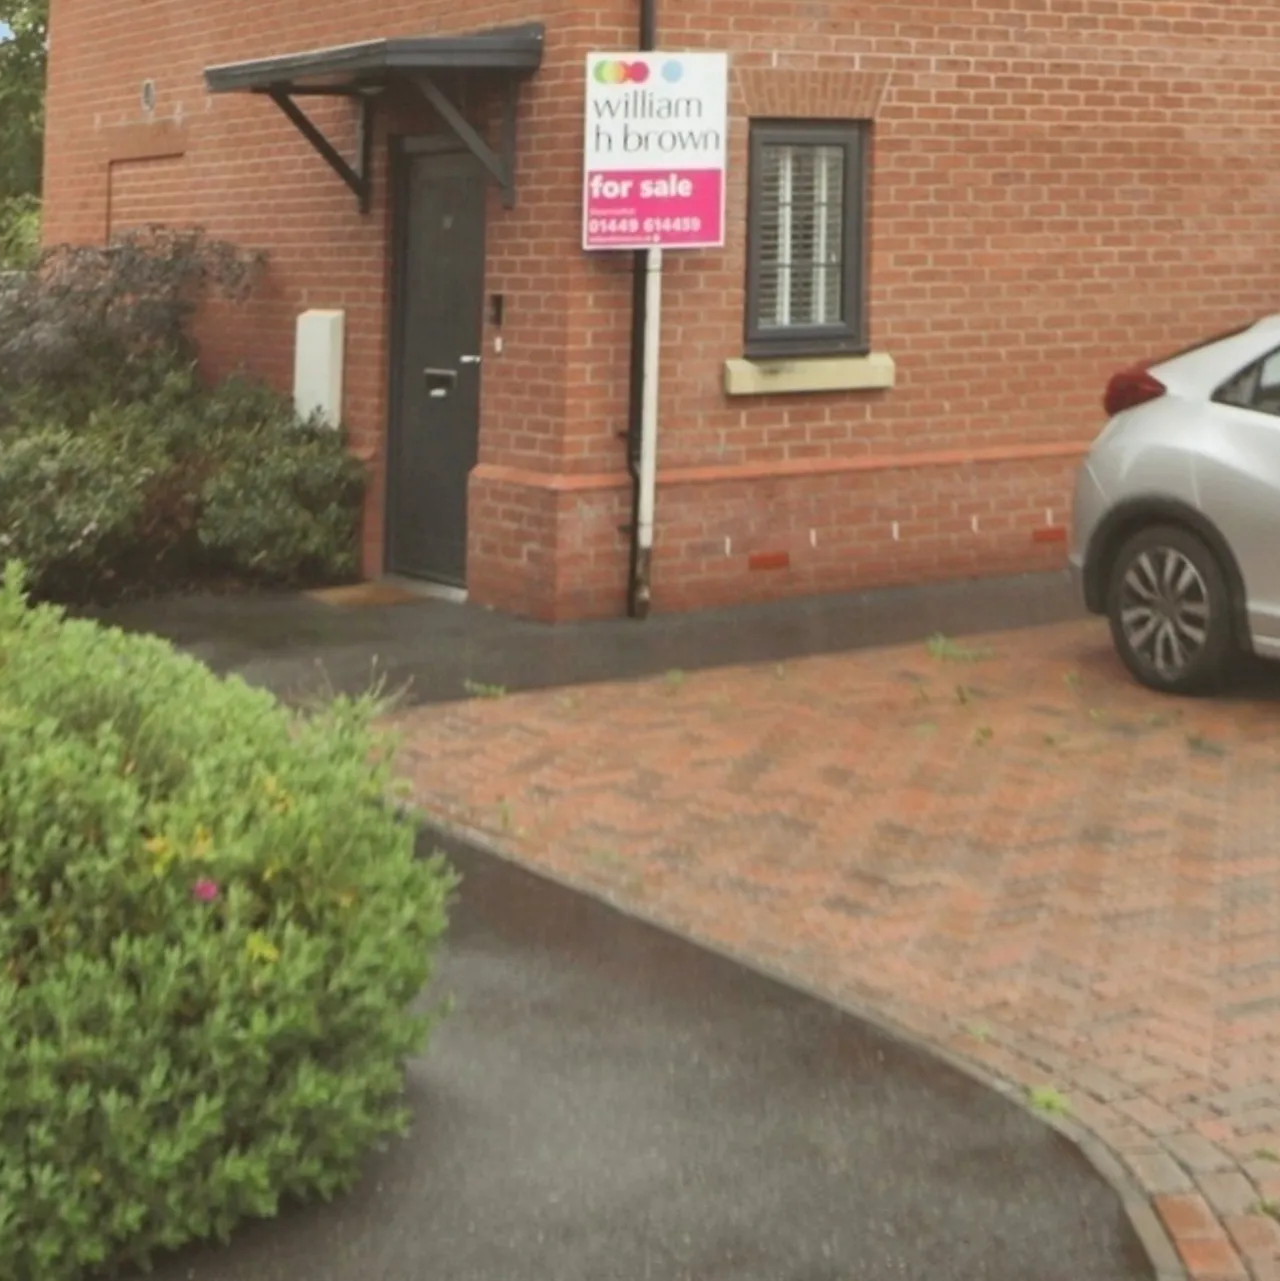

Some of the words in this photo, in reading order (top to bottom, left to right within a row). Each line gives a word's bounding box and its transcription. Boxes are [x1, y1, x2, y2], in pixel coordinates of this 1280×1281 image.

[593, 89, 702, 119] william
[595, 124, 612, 152] h
[623, 123, 720, 152] brown
[590, 174, 632, 198] for
[640, 173, 693, 197] sale
[589, 218, 639, 233] 01449
